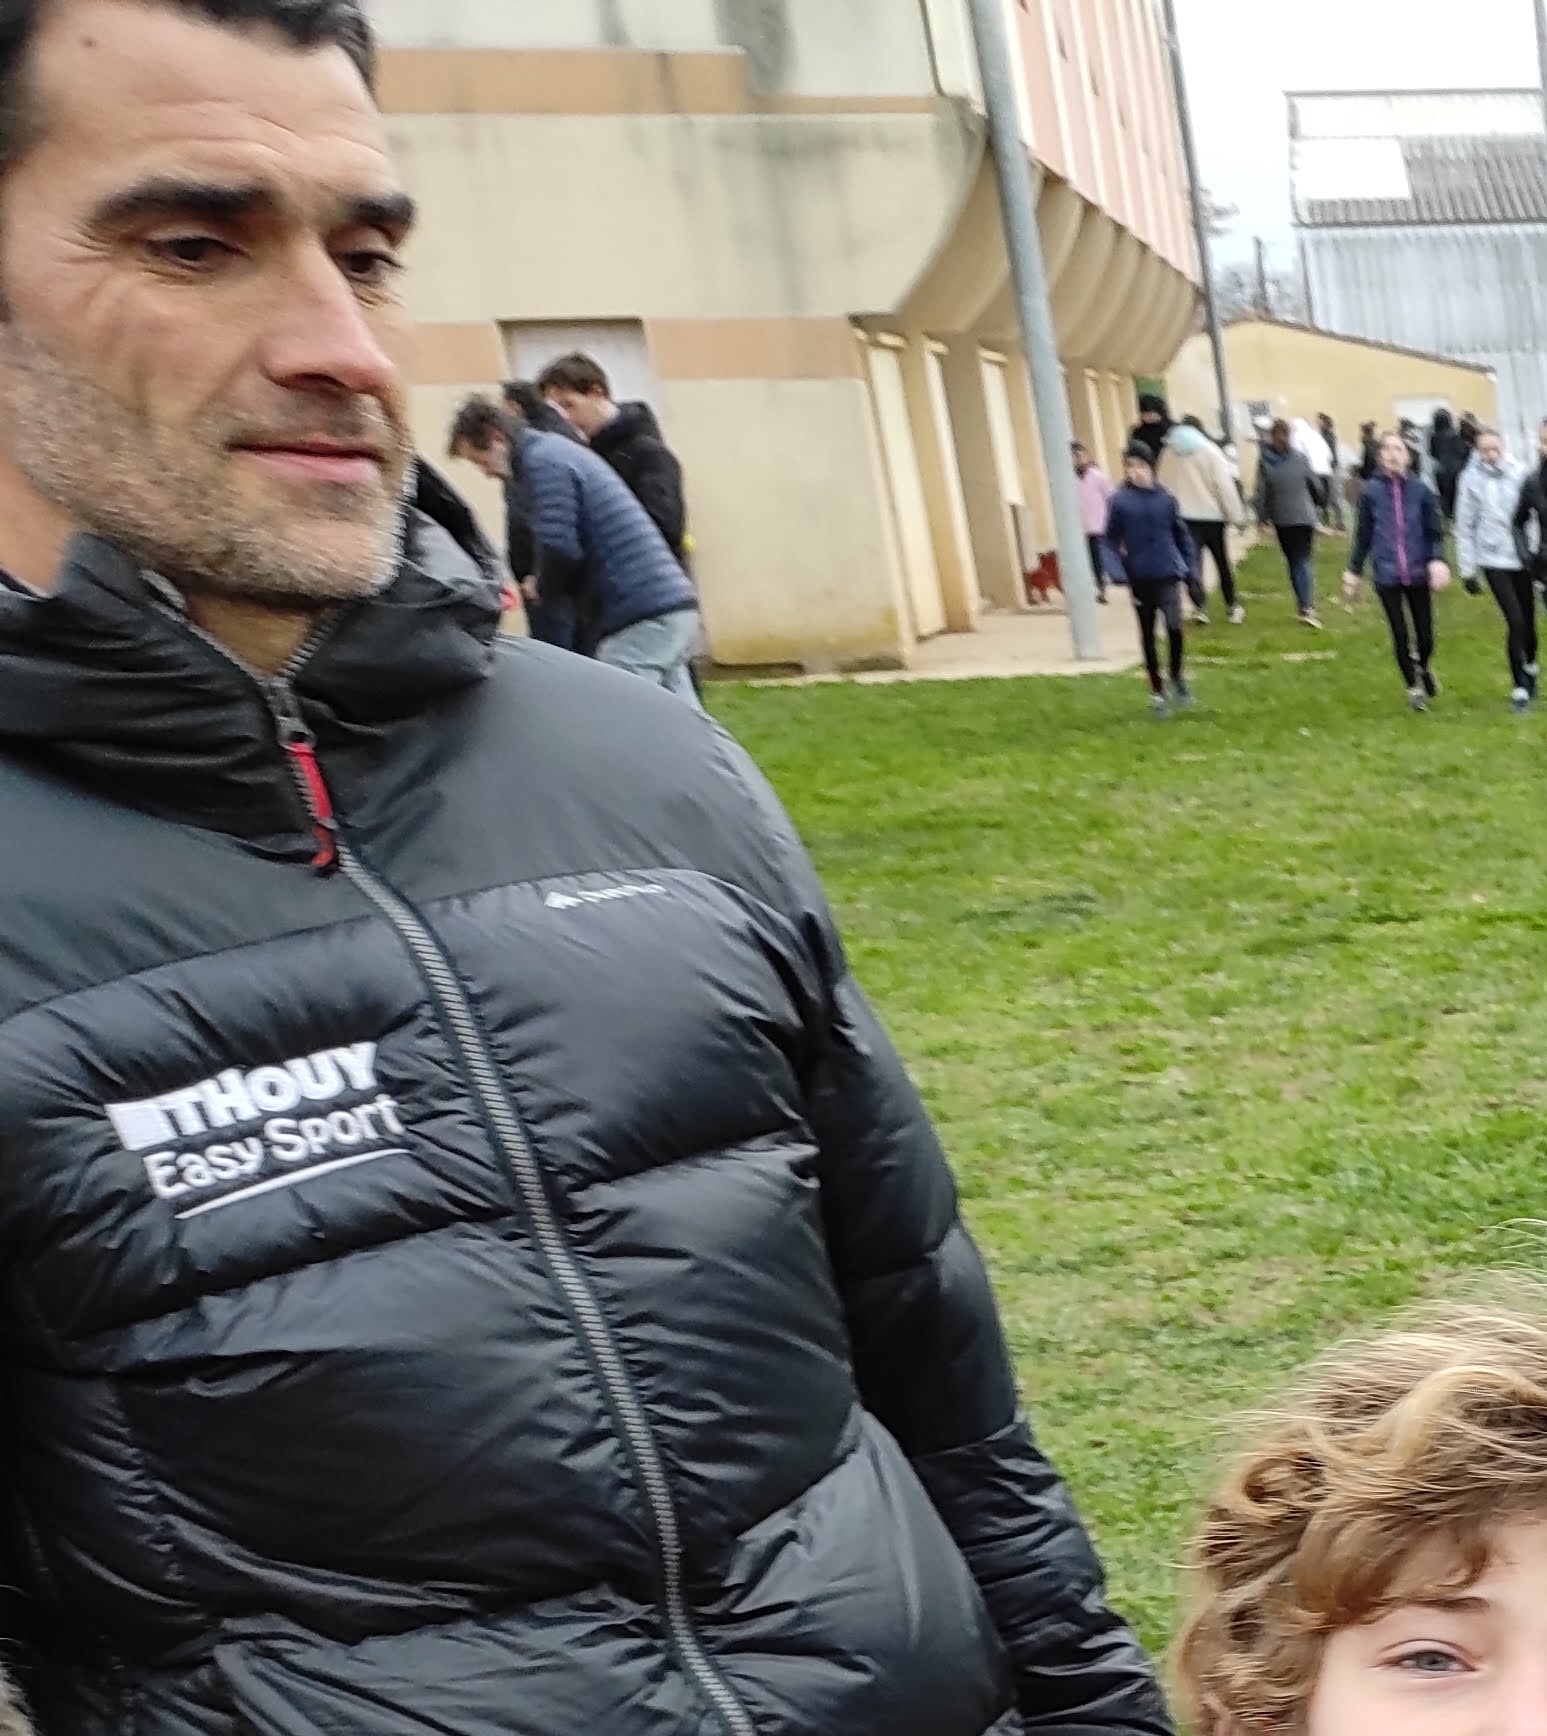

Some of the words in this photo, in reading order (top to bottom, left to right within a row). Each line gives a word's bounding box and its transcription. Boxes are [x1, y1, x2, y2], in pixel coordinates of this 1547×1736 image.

[150, 1041, 377, 1140] THOUY
[144, 1137, 264, 1199] Easy
[263, 1094, 405, 1161] Sport
